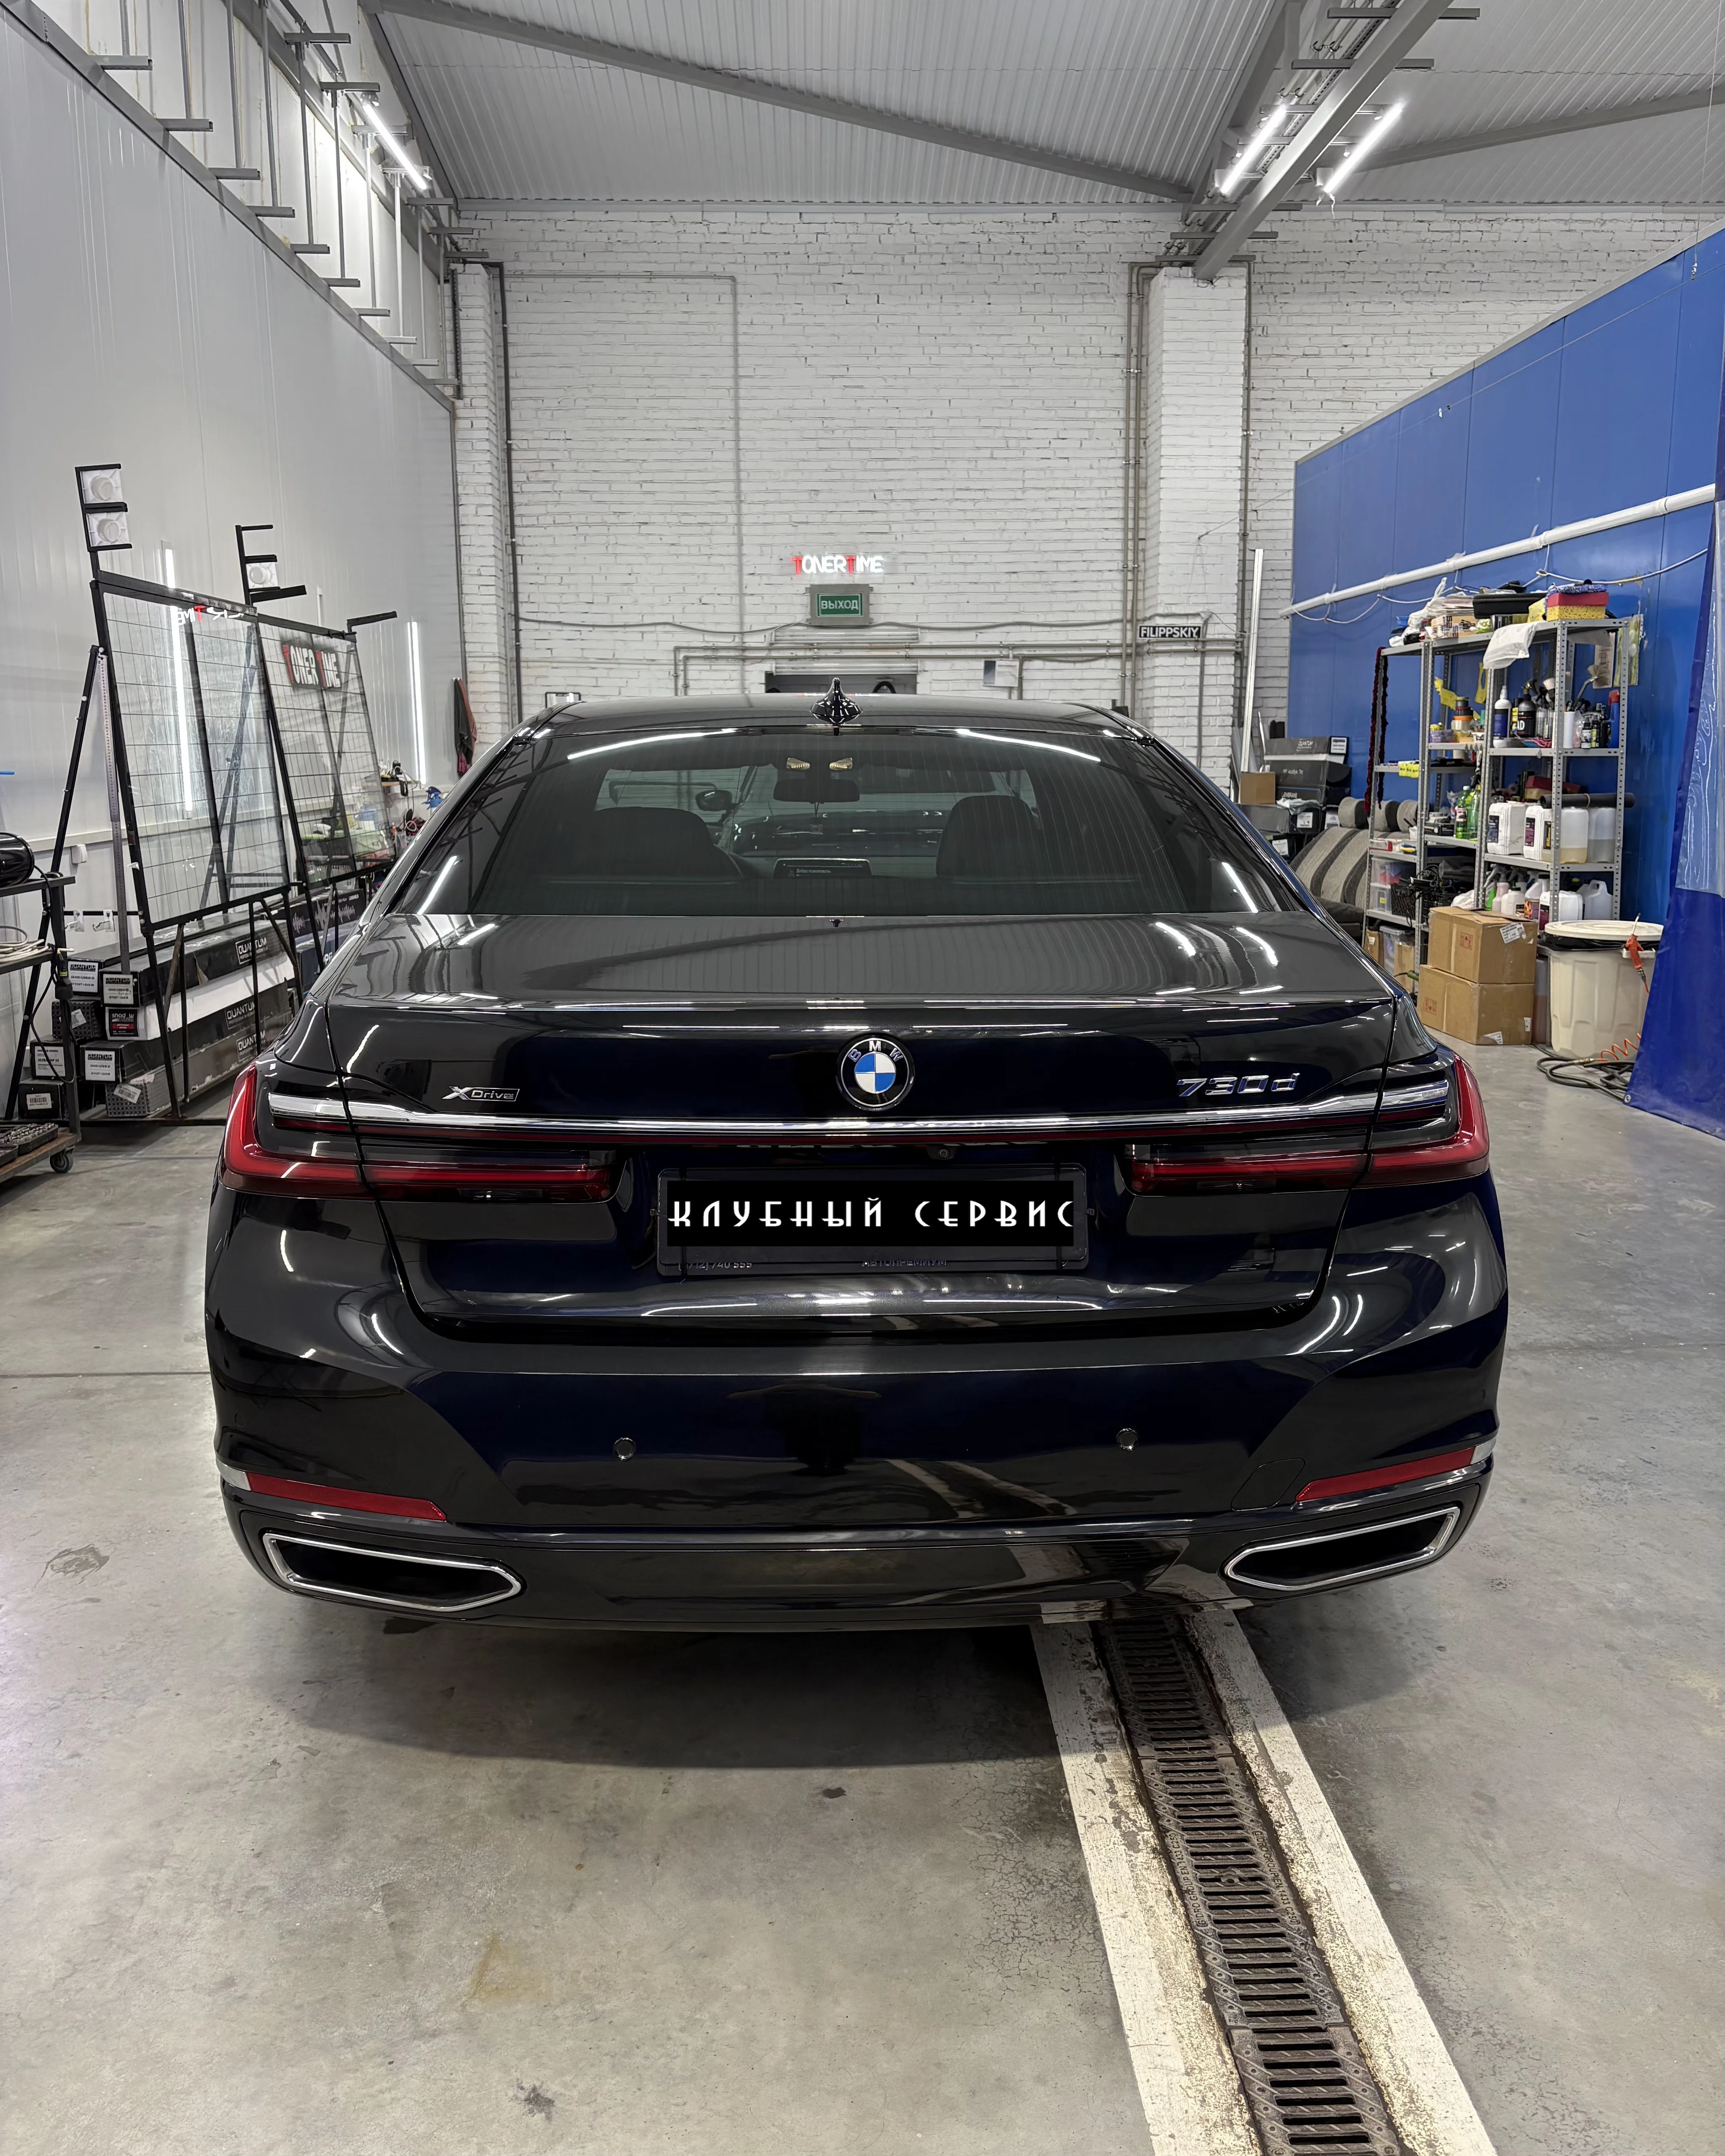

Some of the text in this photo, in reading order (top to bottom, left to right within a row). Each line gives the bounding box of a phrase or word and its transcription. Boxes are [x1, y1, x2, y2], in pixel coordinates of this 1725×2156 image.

[821, 600, 859, 610] ВЫХОД
[1141, 627, 1199, 637] FILIPPSKIY
[238, 937, 267, 954] QUATUM
[238, 1030, 265, 1051] QUANTM
[848, 1040, 904, 1063] BMW
[1177, 1072, 1300, 1097] 730d
[1254, 1831, 1268, 1852] GIDRO
[1264, 1853, 1279, 1878] GROUP
[1183, 1877, 1198, 1901] GROUP
[1192, 1902, 1207, 1926] GIDRO
